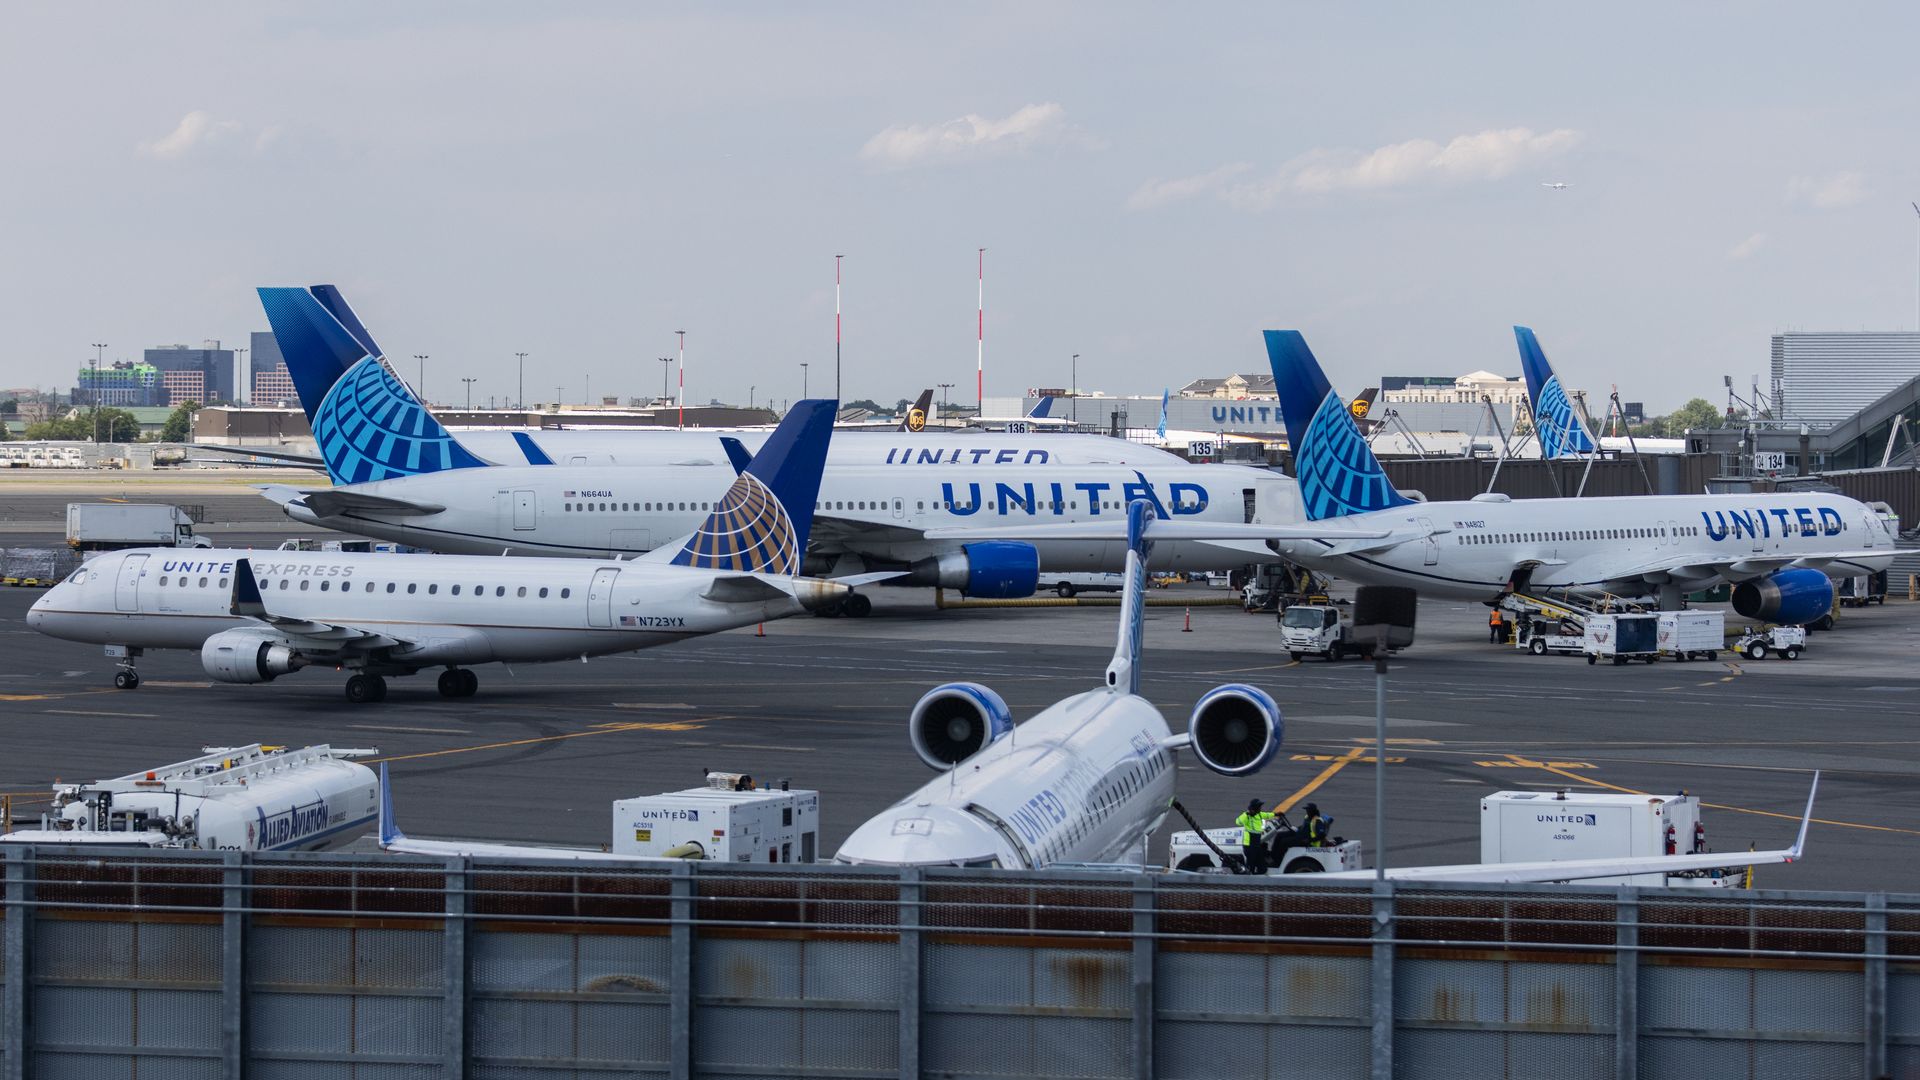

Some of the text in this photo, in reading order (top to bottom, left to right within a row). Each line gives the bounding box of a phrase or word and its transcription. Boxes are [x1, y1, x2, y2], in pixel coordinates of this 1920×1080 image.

[1212, 406, 1284, 424] UNITE
[1008, 423, 1025, 433] 136
[1192, 442, 1211, 455] 135
[886, 448, 1049, 464] UNITED
[1769, 455, 1783, 468] 134
[581, 490, 613, 498] N664UA
[1701, 507, 1842, 542] UNITED
[163, 561, 355, 577] UNITE EXPRESS
[639, 616, 685, 627] N723YX
[642, 811, 687, 819] UNITED
[1009, 790, 1067, 845] UNITED
[1537, 815, 1583, 823] UNITED
[256, 806, 290, 850] ALLIED
[290, 804, 329, 839] AVIATION
